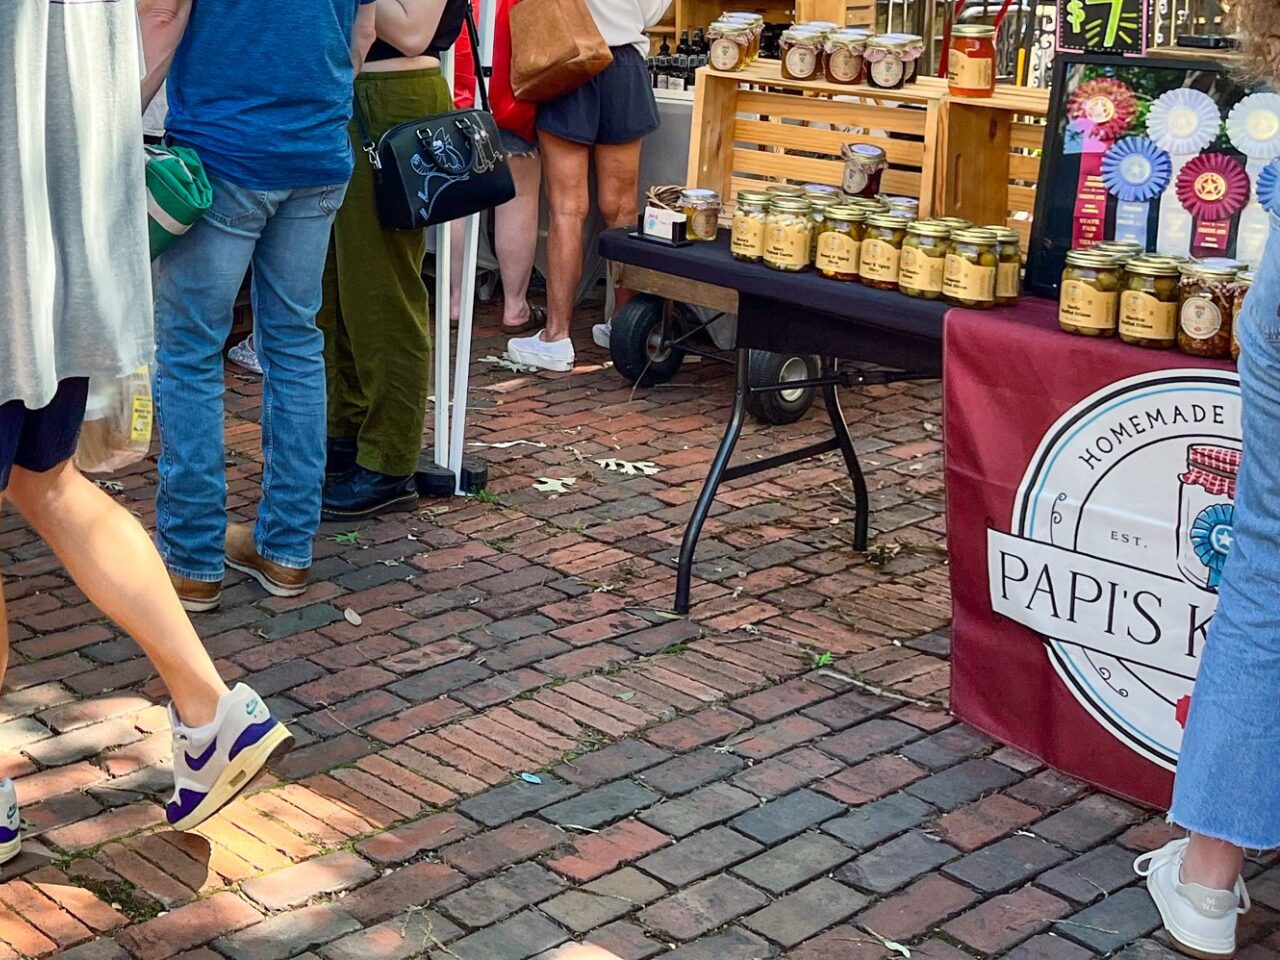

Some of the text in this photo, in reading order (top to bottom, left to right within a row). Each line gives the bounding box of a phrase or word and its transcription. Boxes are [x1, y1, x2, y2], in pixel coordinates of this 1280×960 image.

[1078, 404, 1225, 470] HOMEMADE
[1110, 530, 1148, 549] EST.
[999, 550, 1162, 645] PAPI'S
